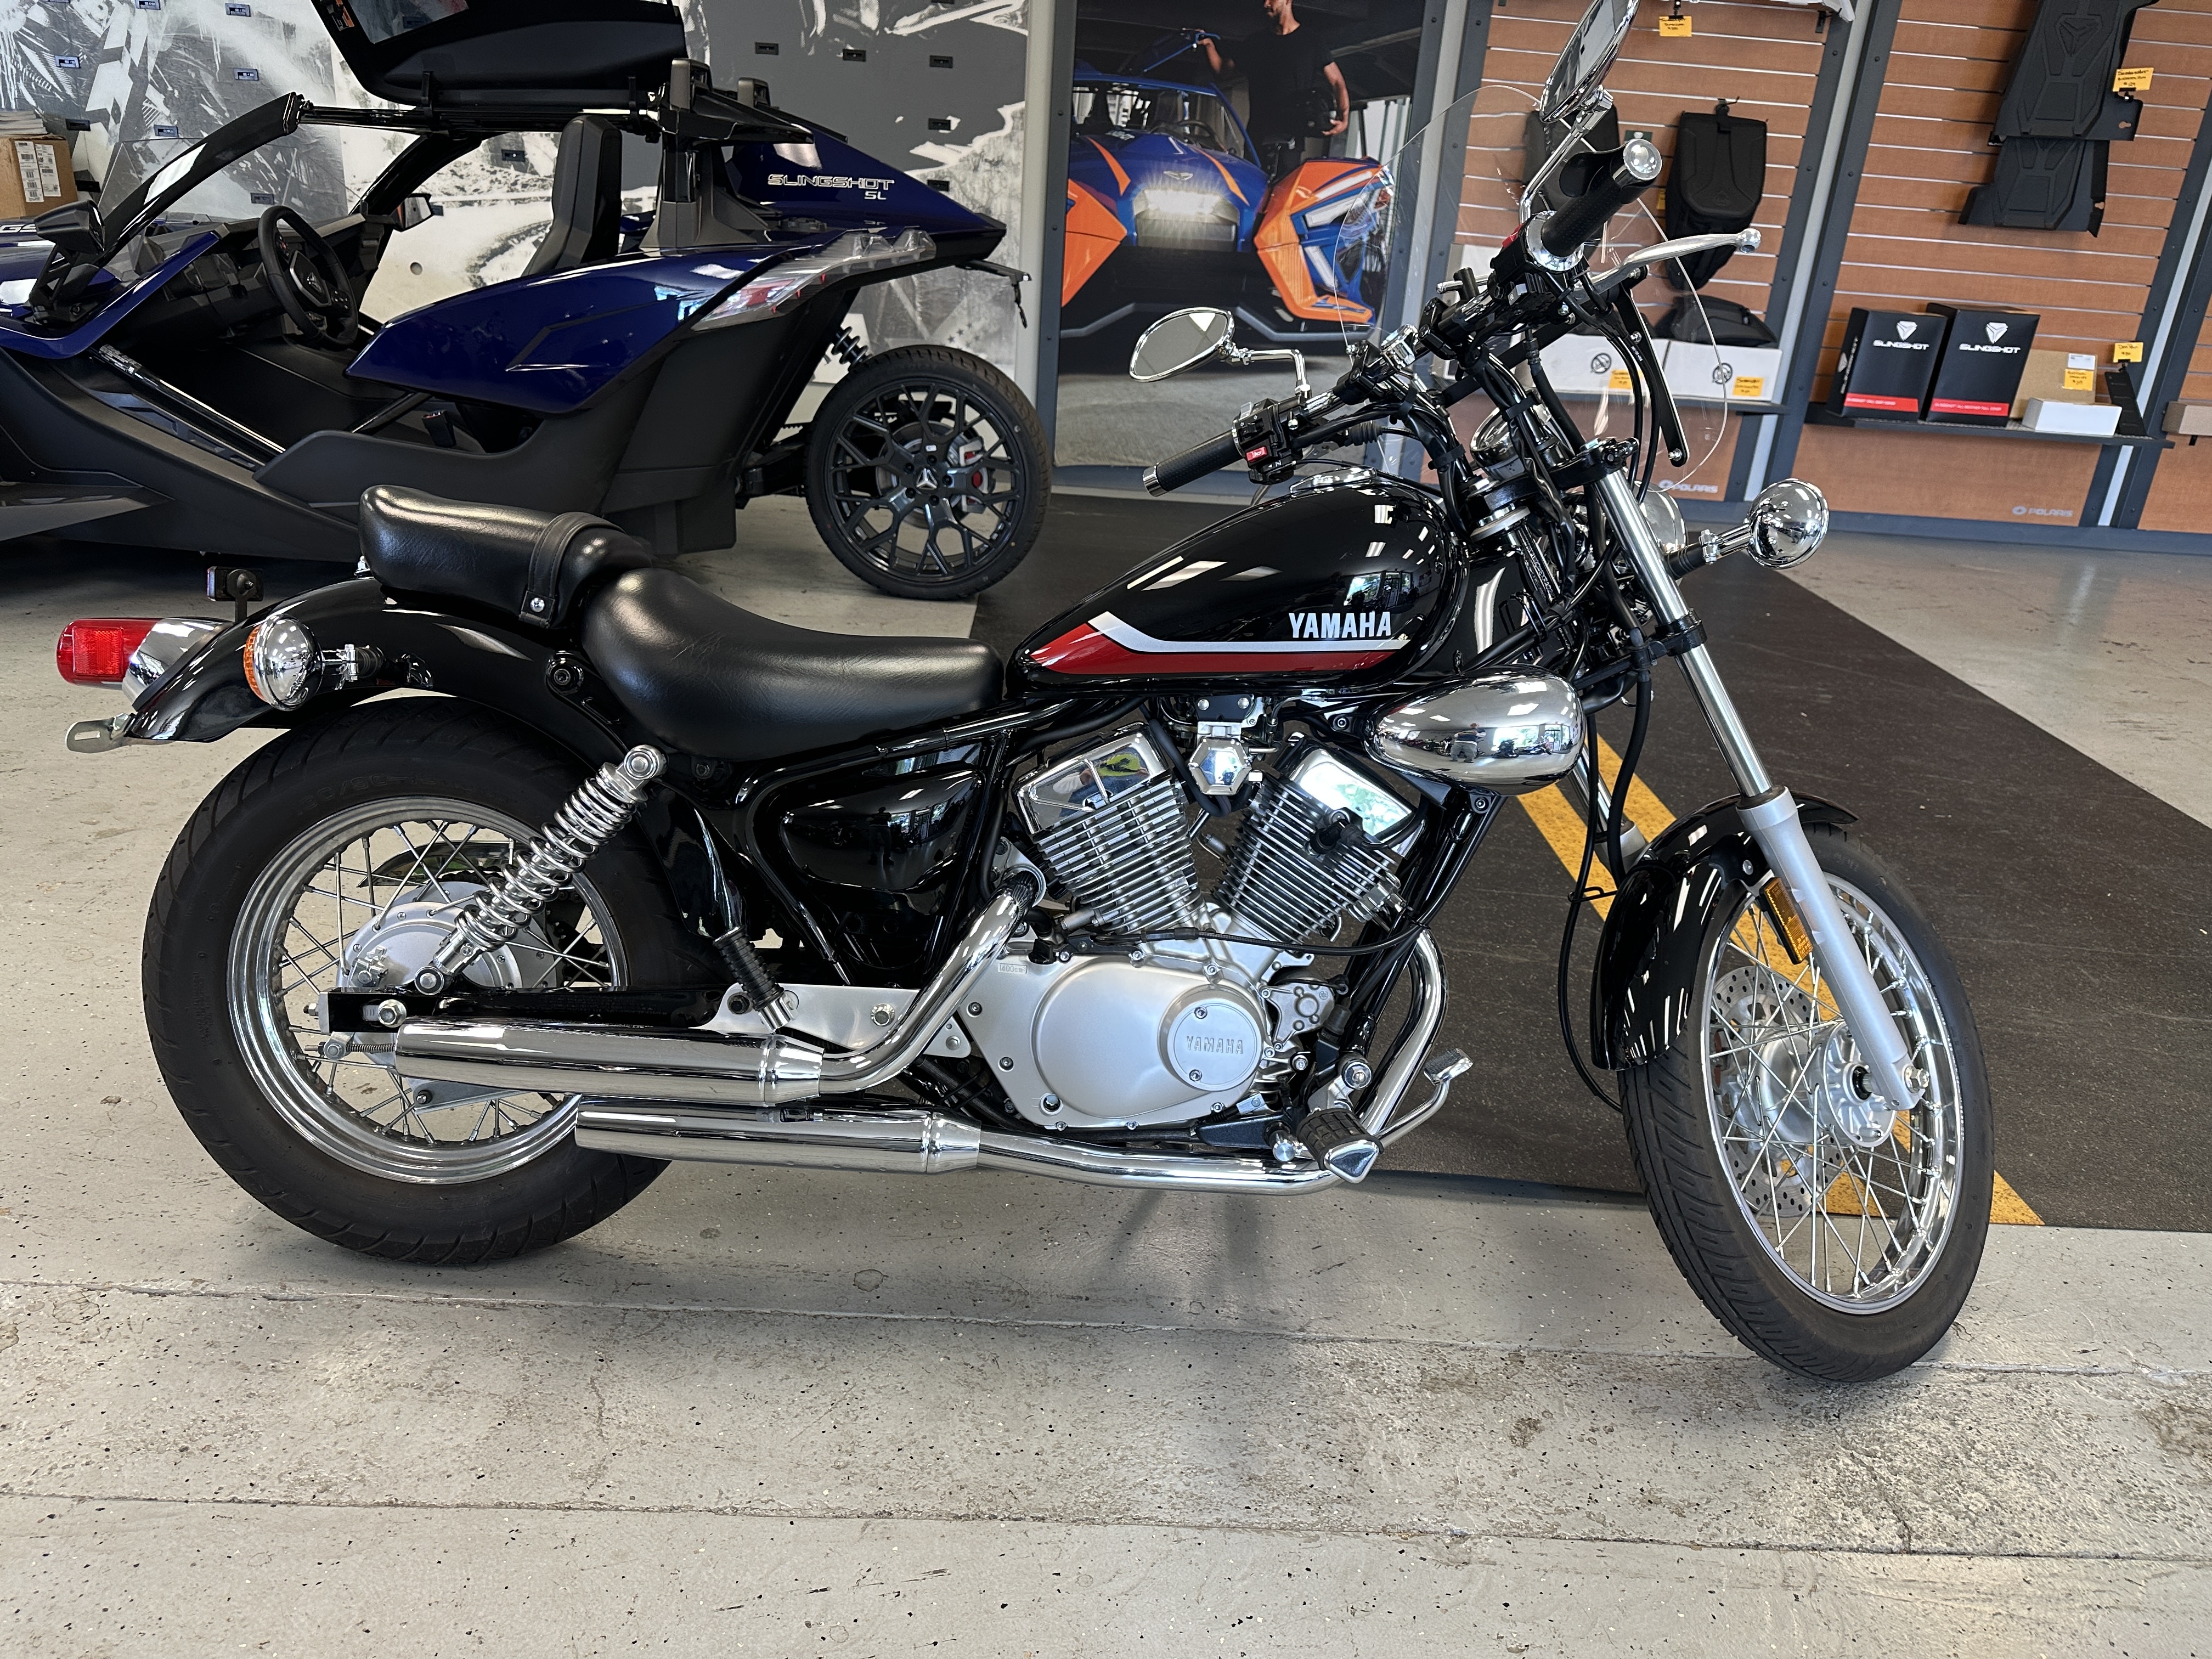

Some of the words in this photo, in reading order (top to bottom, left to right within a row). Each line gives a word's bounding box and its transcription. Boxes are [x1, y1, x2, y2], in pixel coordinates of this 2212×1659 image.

[768, 174, 895, 190] SLINGSHOT
[864, 191, 887, 200] SL
[1872, 339, 1929, 351] SLINGSHOT
[1959, 343, 2021, 354] SLINGSHOT
[1672, 482, 1718, 493] POLARIS
[2029, 507, 2073, 517] POLARIS
[1289, 611, 1391, 639] YAMAHA
[1186, 1035, 1243, 1054] YAMAHA
